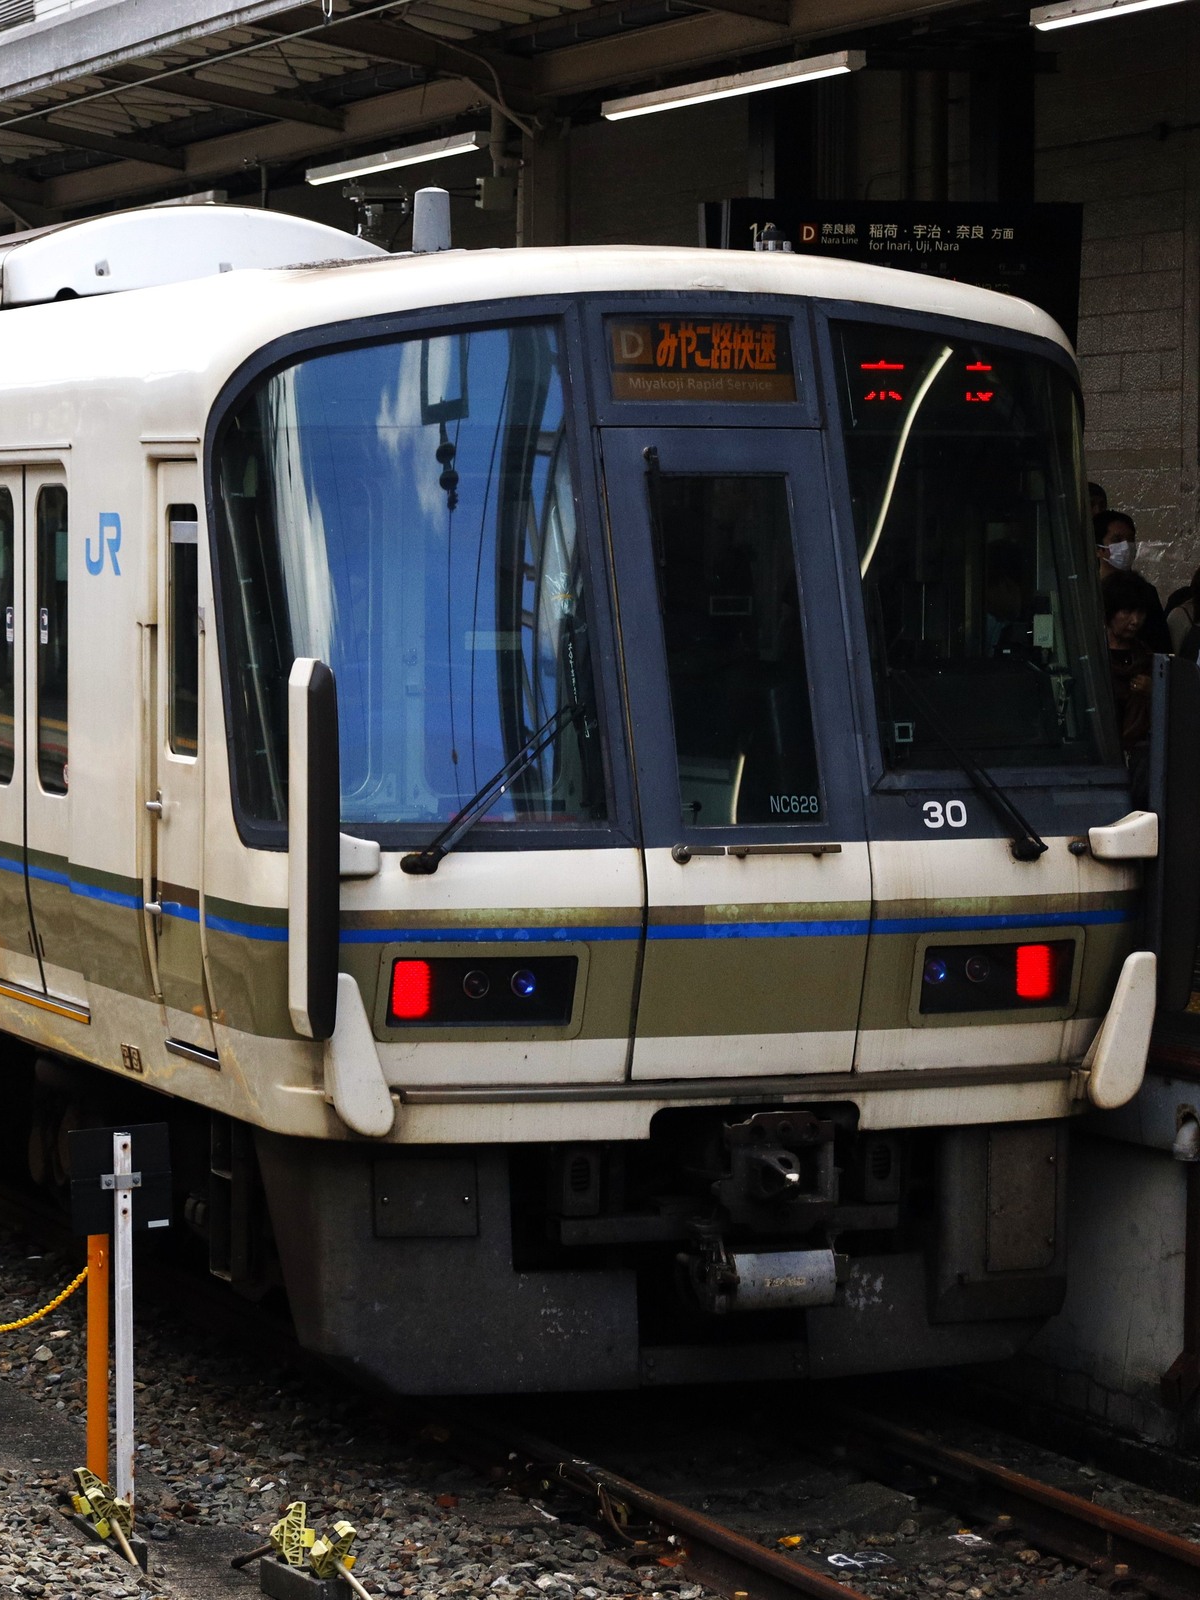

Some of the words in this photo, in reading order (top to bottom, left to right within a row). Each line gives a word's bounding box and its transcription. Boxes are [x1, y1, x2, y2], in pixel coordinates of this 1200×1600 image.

[803, 226, 814, 240] D
[822, 224, 856, 235] 奈良線
[991, 227, 1014, 240] 方面
[821, 236, 839, 244] Nara
[842, 236, 858, 244] Line
[869, 241, 883, 250] for
[887, 241, 913, 252] Inari,
[916, 241, 933, 253] Uji,
[935, 242, 959, 250] Nara
[621, 331, 644, 359] D
[656, 321, 777, 370] みやこ路快速
[629, 377, 684, 393] Miyakoji
[688, 377, 723, 392] Rapid
[728, 379, 772, 391] Service
[85, 512, 121, 576] JR
[770, 795, 818, 814] NC628
[922, 800, 968, 829] 30
